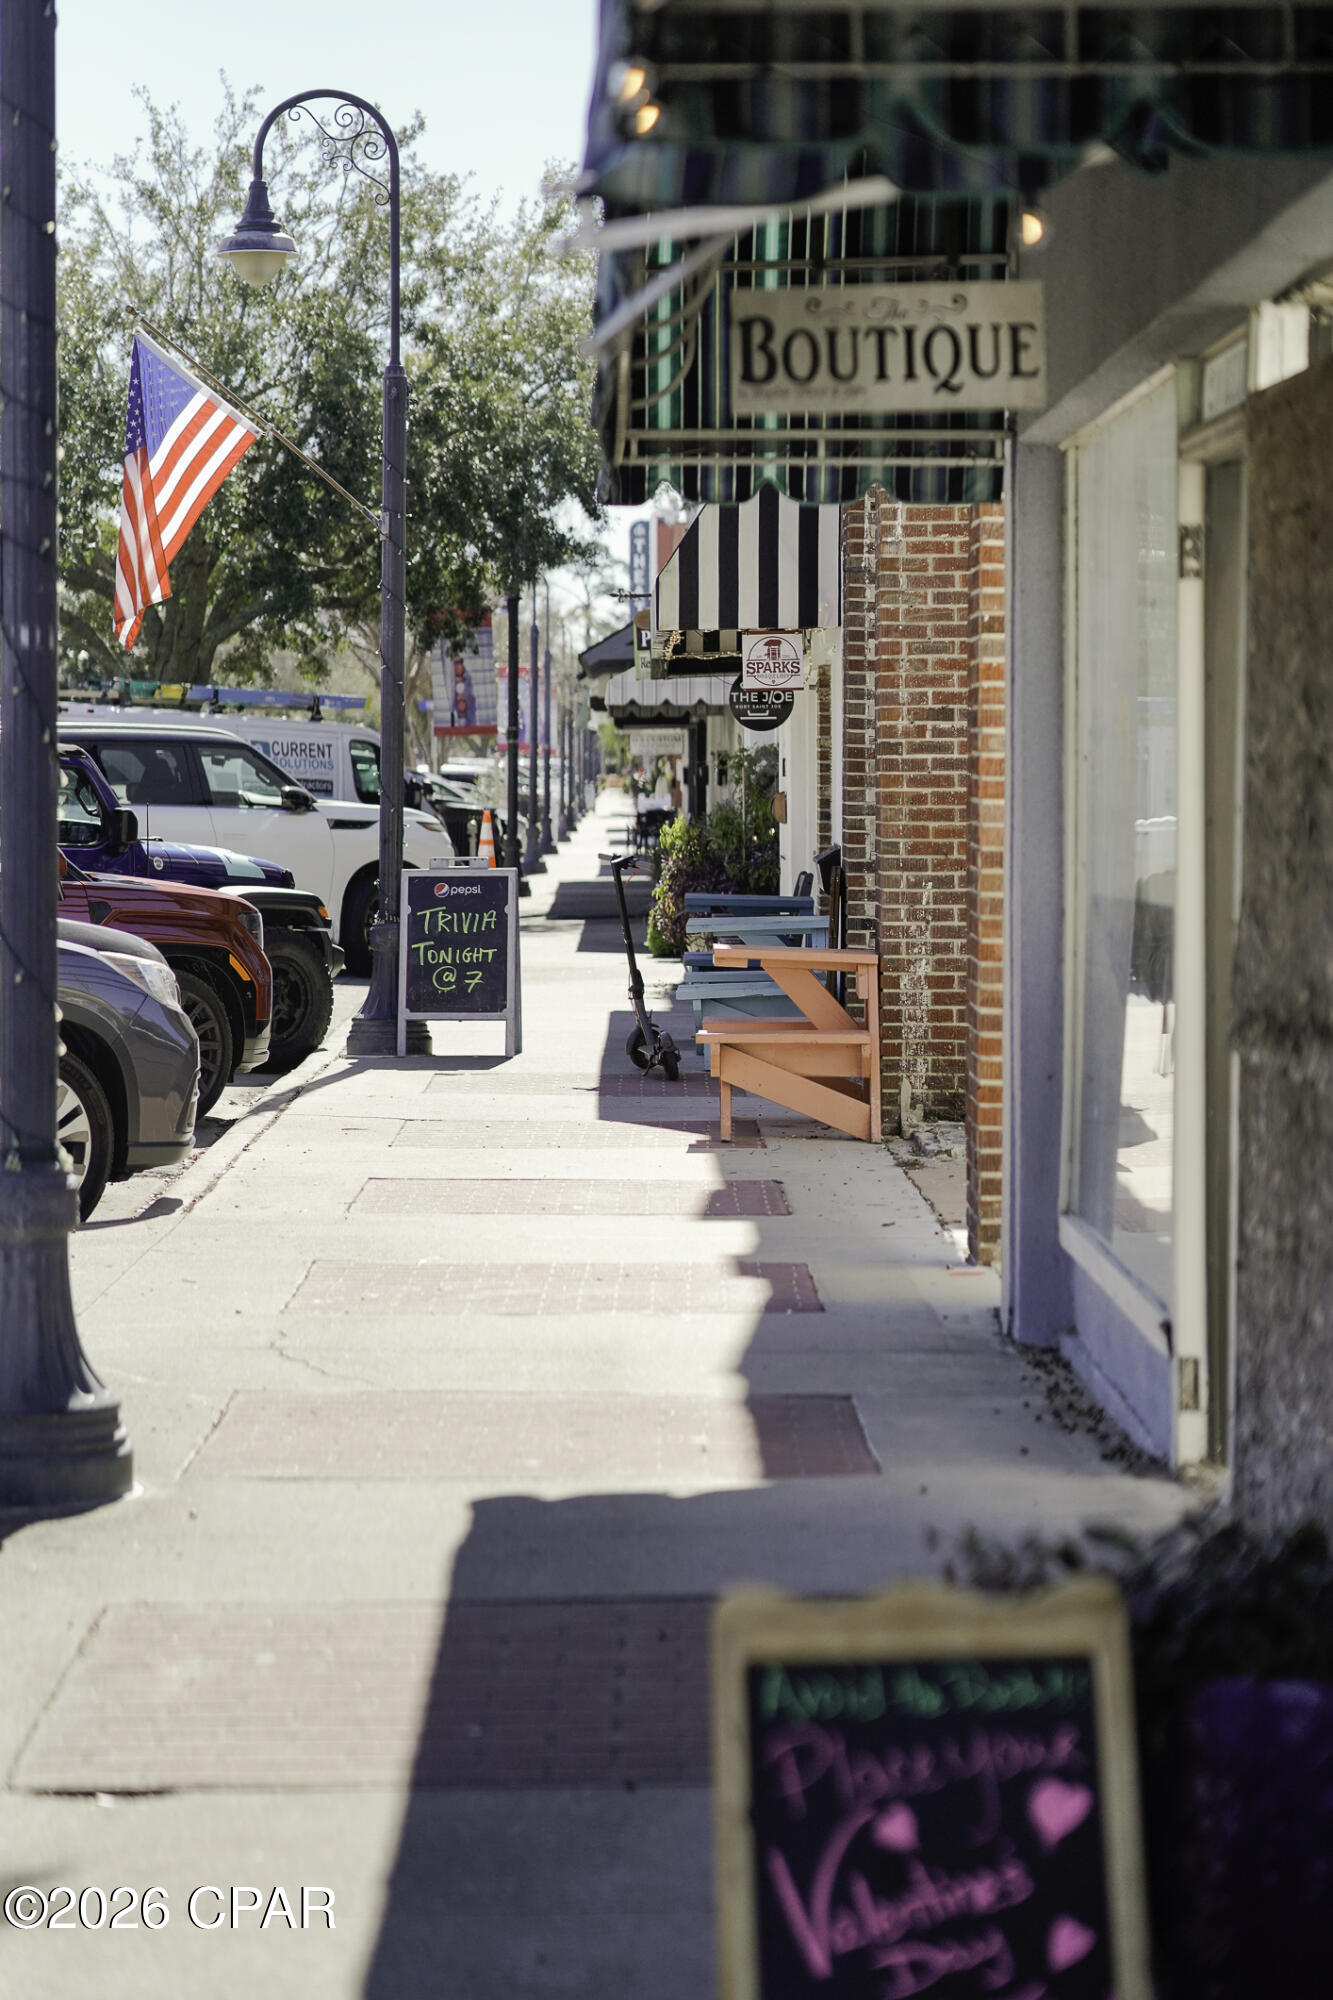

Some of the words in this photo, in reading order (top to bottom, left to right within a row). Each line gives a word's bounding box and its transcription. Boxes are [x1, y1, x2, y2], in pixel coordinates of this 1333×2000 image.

[738, 315, 1041, 395] BOUTIQUE
[746, 661, 800, 675] SPARKS
[730, 692, 758, 703] THE
[271, 740, 333, 759] CURRENT
[450, 884, 481, 896] pepsi
[416, 906, 497, 935] TRIVIA
[411, 940, 498, 966] TONIGHT
[432, 965, 457, 991] @
[464, 970, 484, 993] 7
